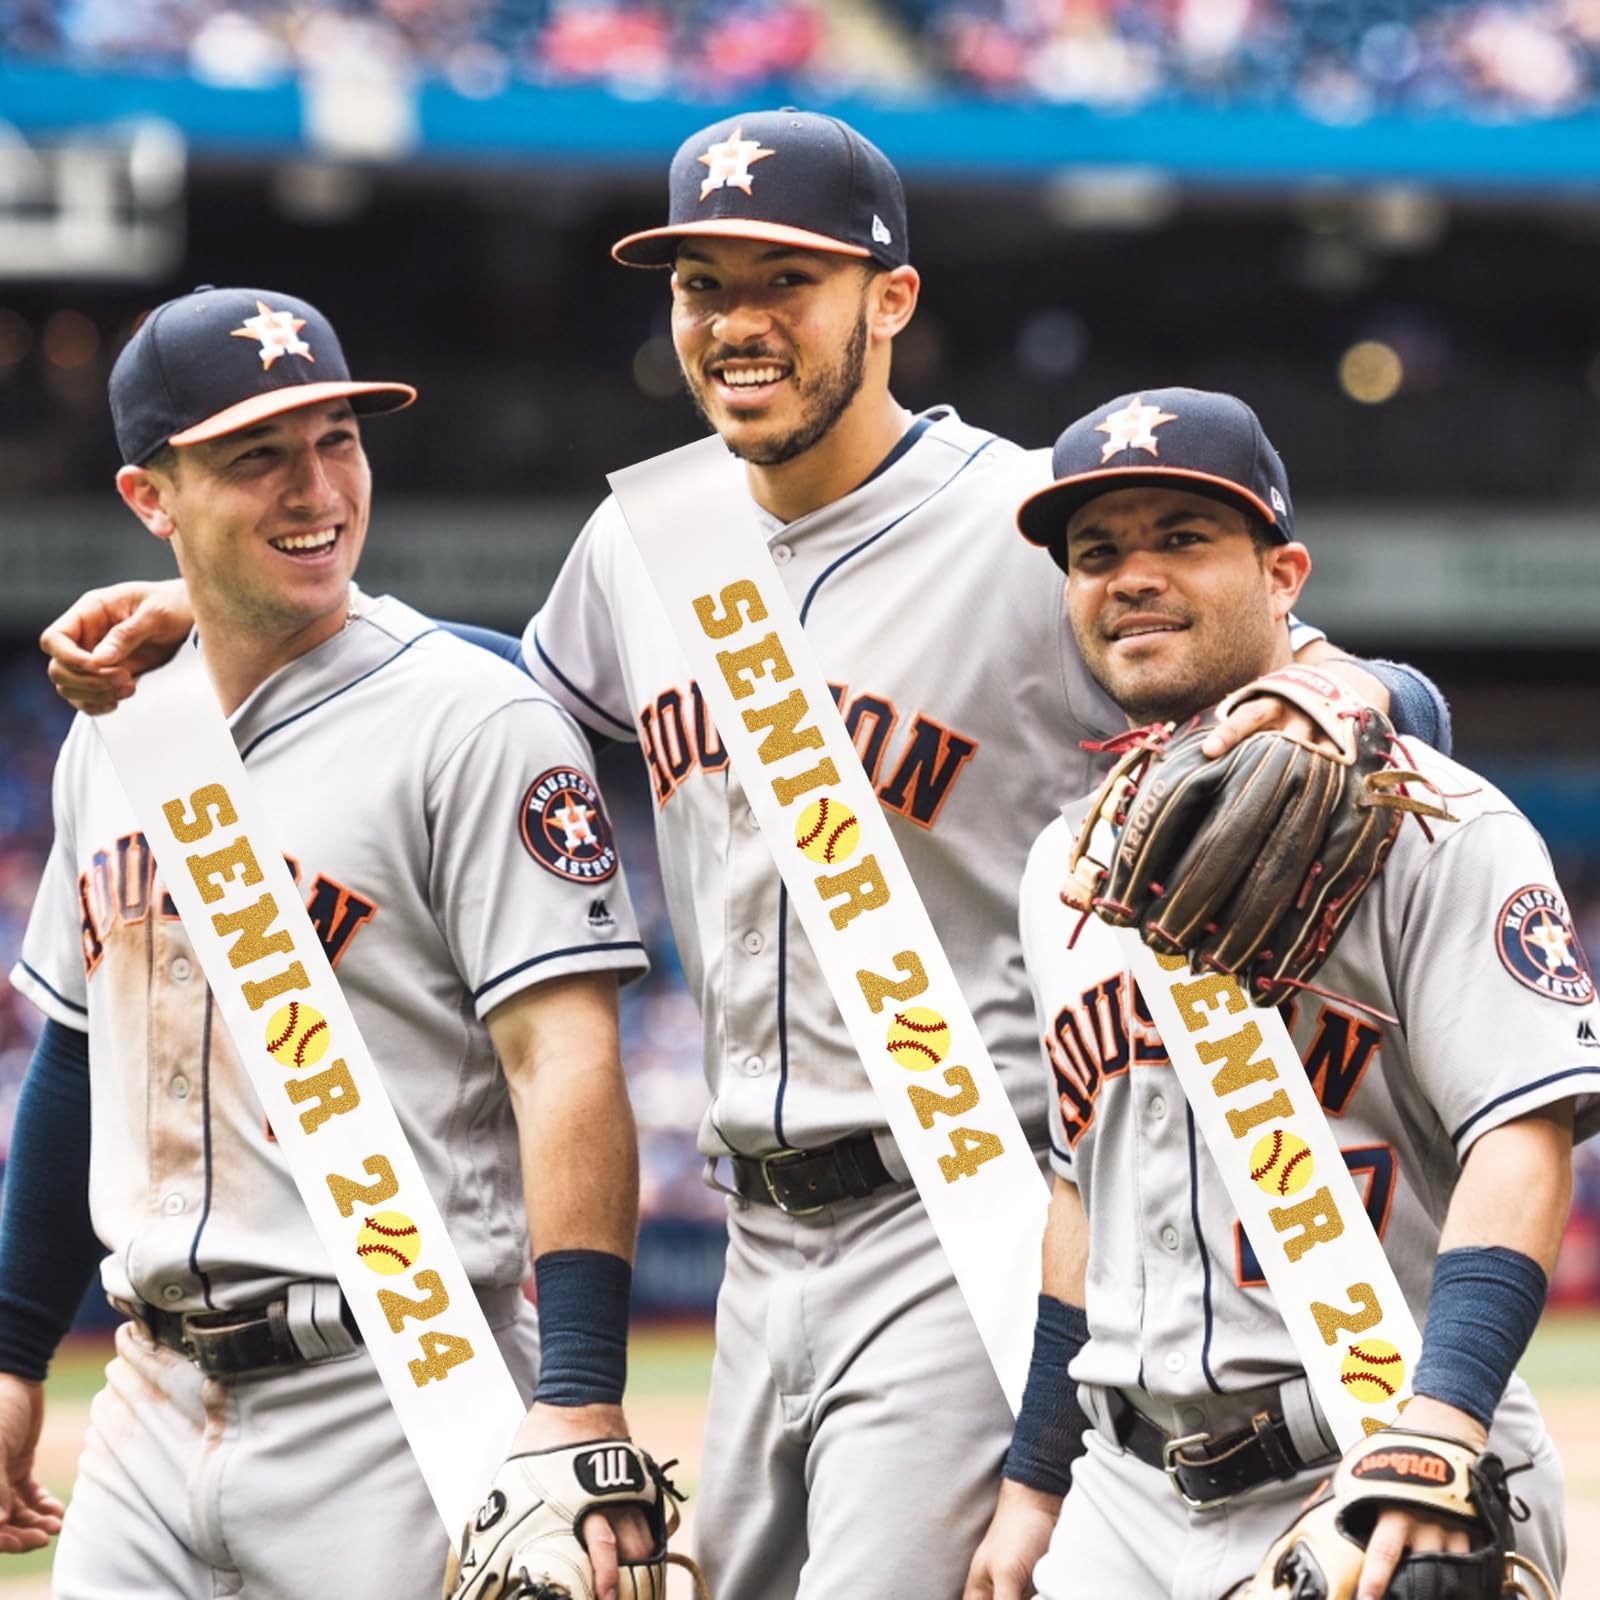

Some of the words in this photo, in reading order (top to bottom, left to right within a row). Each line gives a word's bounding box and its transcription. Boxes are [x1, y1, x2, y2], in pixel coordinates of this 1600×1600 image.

[529, 772, 596, 813] HOUSTON
[640, 679, 979, 831] HOUON
[78, 831, 378, 981] HOUN
[554, 847, 615, 877] ASTROS
[856, 950, 1004, 1184] 2024
[1046, 972, 1382, 1149] HOUN
[326, 1154, 474, 1388] 2024
[1155, 950, 1344, 1263] ENIOR
[1311, 1282, 1412, 1437] 20
